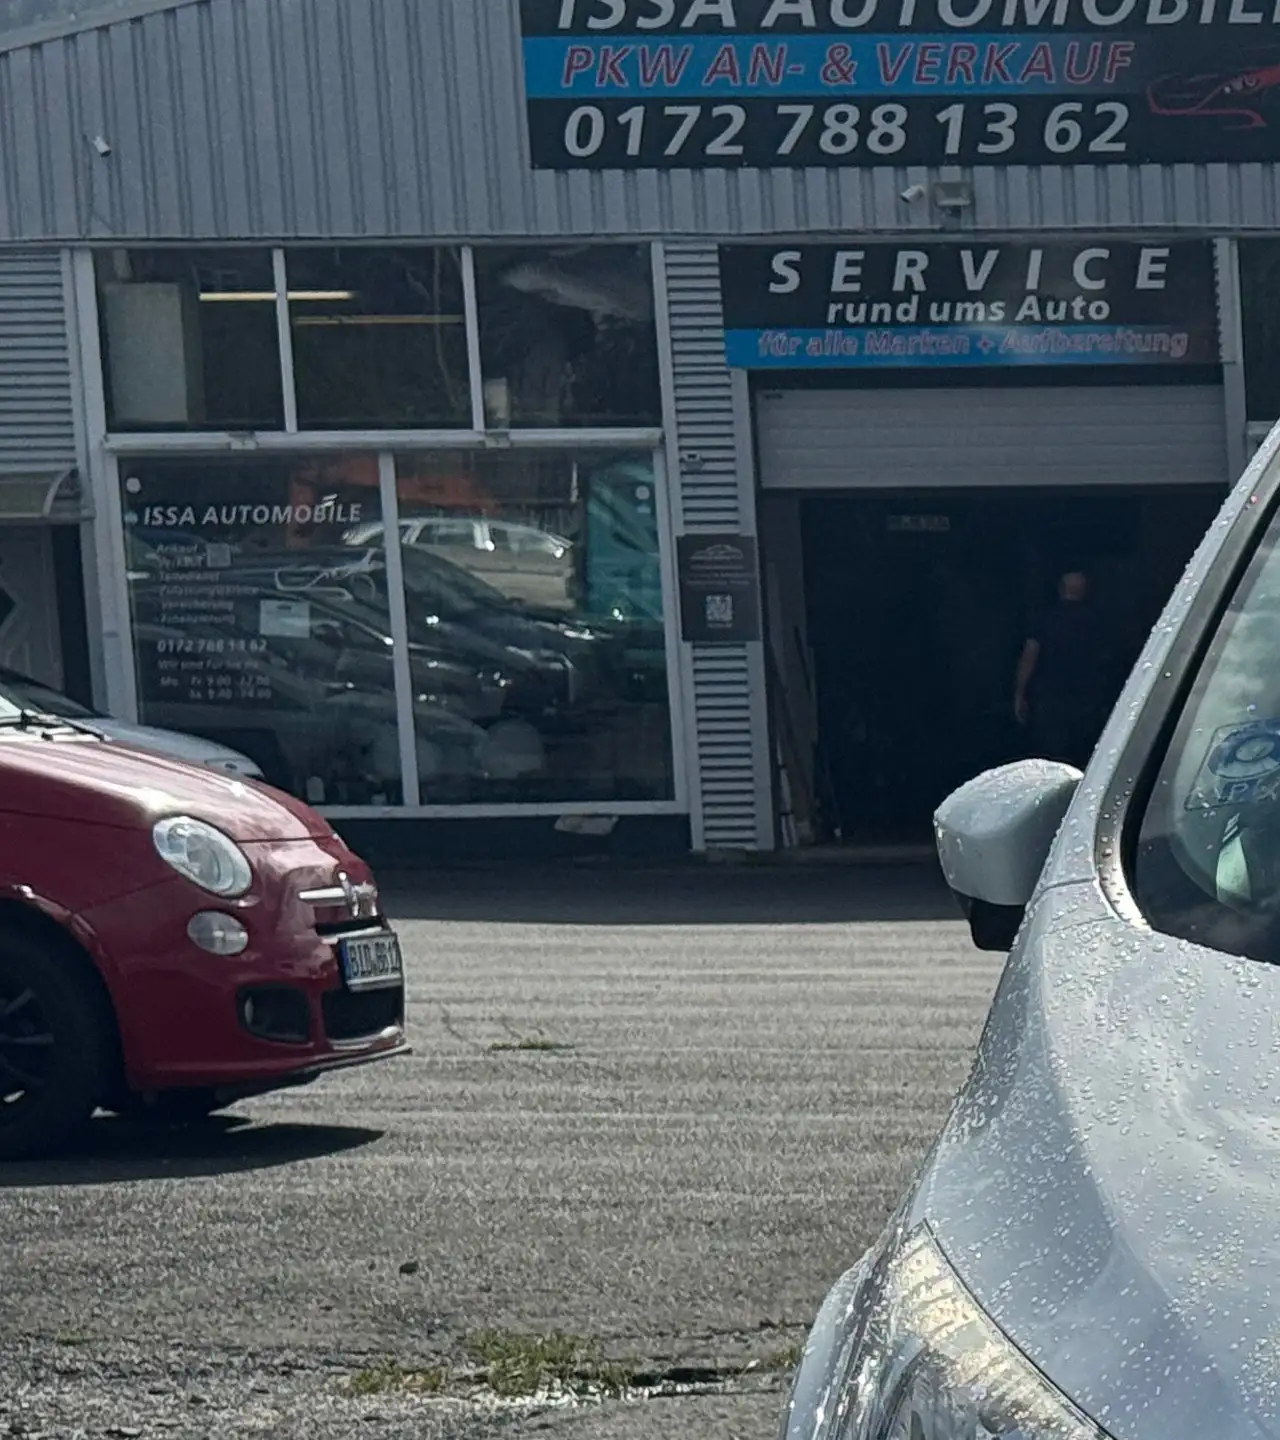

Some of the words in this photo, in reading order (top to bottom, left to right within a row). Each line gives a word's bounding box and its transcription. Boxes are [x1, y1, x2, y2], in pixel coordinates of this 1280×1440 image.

[560, 43, 694, 88] PKW
[700, 43, 805, 88] AN-
[819, 42, 859, 87] &
[876, 41, 1136, 87] VERKAUF
[563, 103, 747, 158] 0172
[775, 102, 909, 156] 788
[935, 102, 1019, 155] 13
[1043, 101, 1131, 154] 62
[768, 247, 1171, 294] SERVICE
[826, 295, 919, 324] rund
[929, 300, 1006, 323] ums
[1014, 294, 1111, 321] Auto
[757, 329, 803, 358] für
[805, 329, 859, 357] alle
[864, 328, 971, 356] Marken
[977, 335, 994, 354] +
[998, 326, 1189, 358] Aufbereitung
[143, 505, 196, 527] ISSA
[201, 503, 363, 525] AUTOMOBILE
